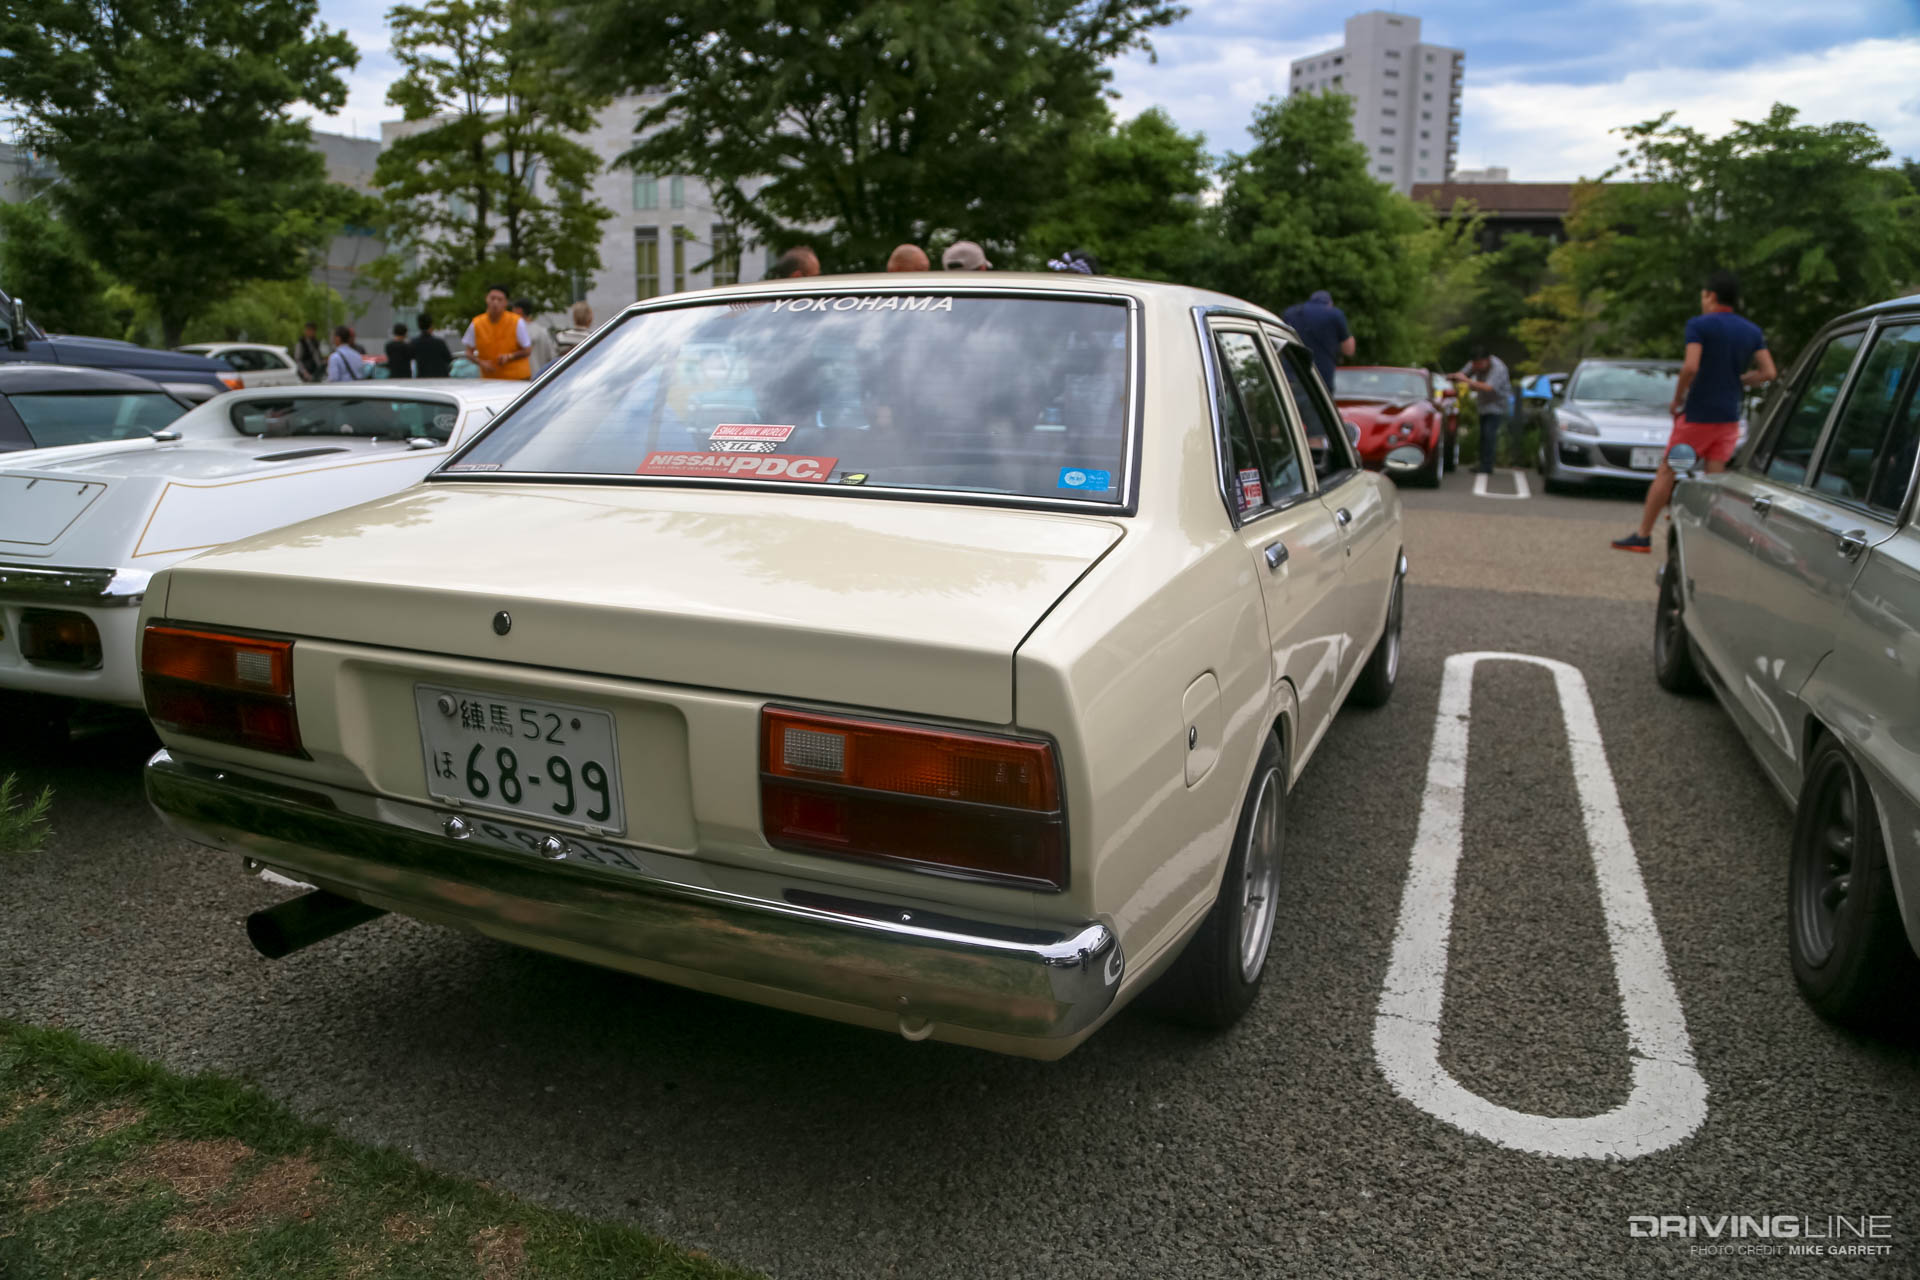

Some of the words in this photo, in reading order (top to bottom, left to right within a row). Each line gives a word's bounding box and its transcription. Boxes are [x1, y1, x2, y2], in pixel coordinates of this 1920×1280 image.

[772, 296, 953, 313] YOKOHAMA
[759, 427, 788, 437] WORLD
[649, 455, 736, 466] NISSAN
[460, 699, 513, 737] 練馬
[520, 708, 566, 746] 52
[433, 751, 457, 780] ほ
[466, 743, 611, 823] 68-99
